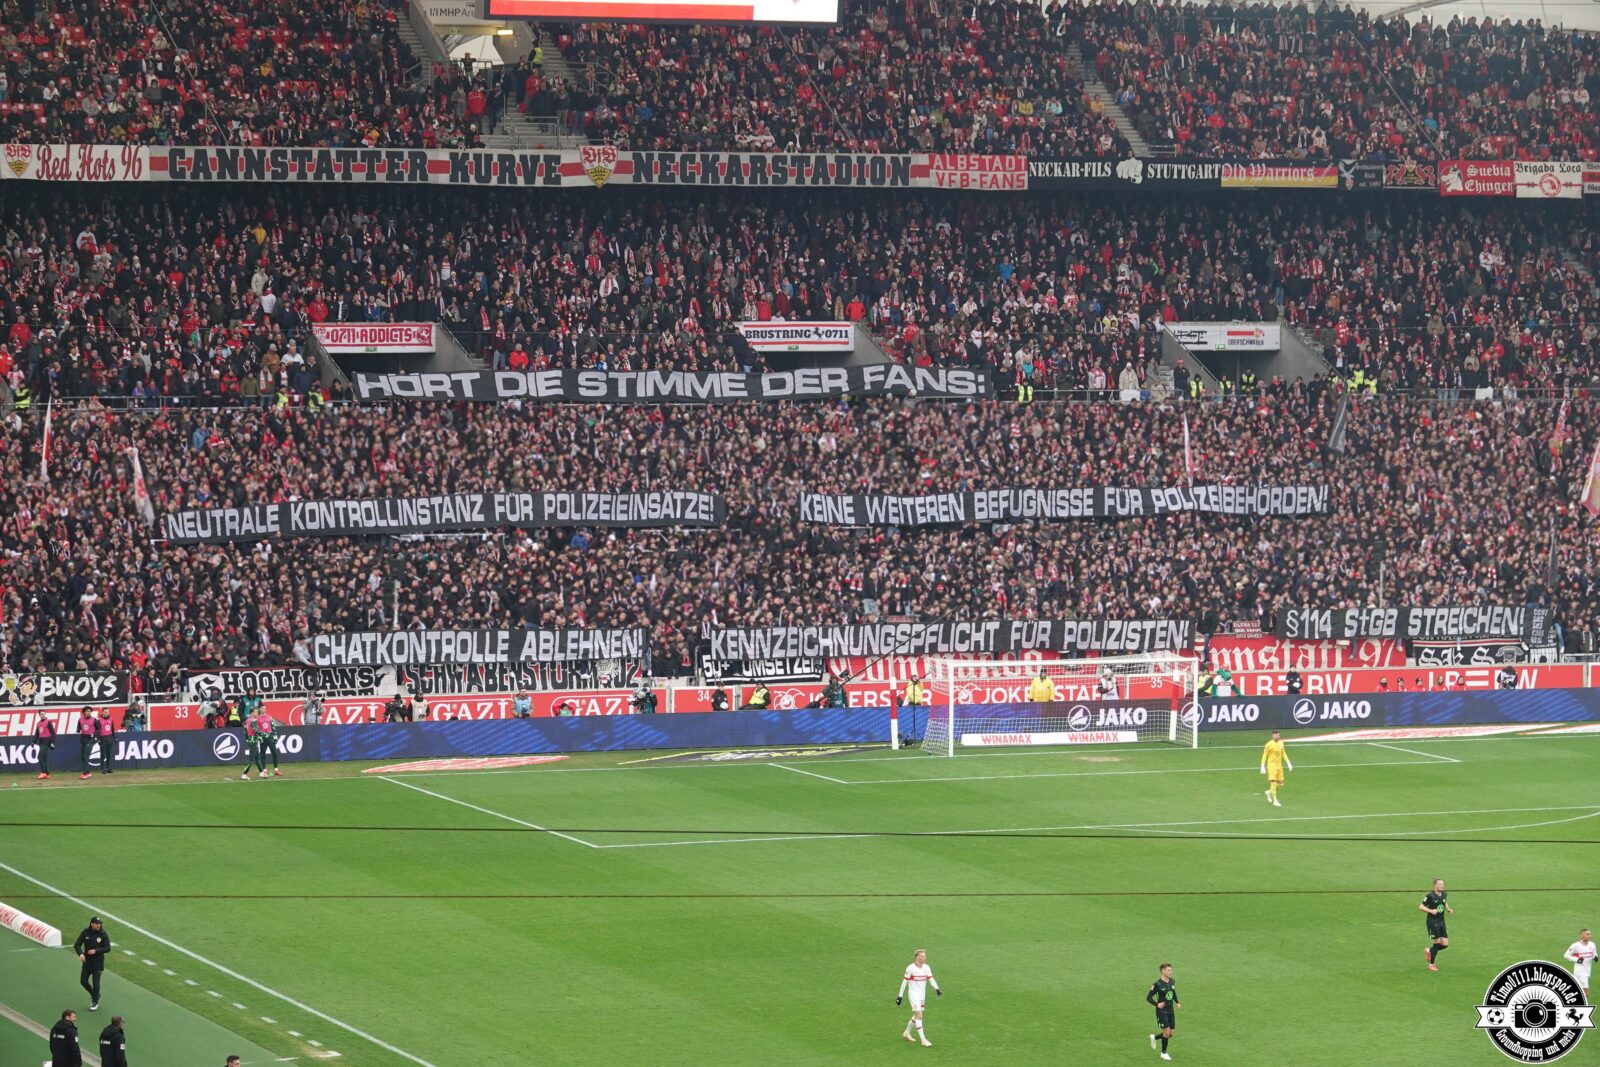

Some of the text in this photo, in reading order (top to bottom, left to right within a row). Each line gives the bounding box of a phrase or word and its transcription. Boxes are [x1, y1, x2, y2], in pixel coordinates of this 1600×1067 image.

[36, 143, 143, 181] Red Hots 96
[168, 147, 562, 186] CANNSTATTER KURVE
[632, 151, 912, 187] NECKARSTADION
[933, 154, 1028, 171] ALBSTADT
[1028, 161, 1222, 180] NECKAR-FILS STUTTGART
[1466, 164, 1511, 177] Suebia
[1514, 162, 1555, 175] Brigada
[1559, 162, 1581, 173] Loca
[935, 171, 1026, 189] VFB-FANS
[1464, 179, 1513, 194] Ehingen
[330, 328, 356, 343] 0711
[360, 327, 412, 343] ADDICTS
[744, 329, 849, 339] BRUSTRING 0711
[356, 363, 986, 399] HÖRT DIE STIMME DER FANS:
[167, 489, 714, 539] NEUTRALE KONTROLLINSTANZ FÜR POLIZEIEINSÄTZE!
[799, 492, 856, 524] KEINE
[864, 493, 964, 524] WEITEREN
[974, 488, 1095, 520] BEFUGNISSE
[1104, 486, 1144, 516] FÜR
[1285, 608, 1332, 639] §114
[1344, 607, 1399, 638] StGB
[1407, 605, 1526, 637] STREICHEN!
[313, 628, 643, 666] CHATKONTROLLE ABLEHNEN!
[710, 620, 1189, 660] KENNZEICHNUNGSPFLICHT FÜR POLIZISTEN!
[1358, 638, 1397, 668] 97
[40, 674, 119, 698] BWOYS
[219, 666, 375, 694] HOOLIGANS
[1150, 676, 1163, 688] 35
[697, 690, 710, 702] 34
[174, 706, 189, 718] 33
[1095, 707, 1148, 726] JAKO
[1207, 704, 1260, 723] JAKO
[1319, 700, 1372, 720] JAKO
[981, 732, 1119, 745] WINAMAX WINAMAX
[114, 738, 175, 761] JAKO
